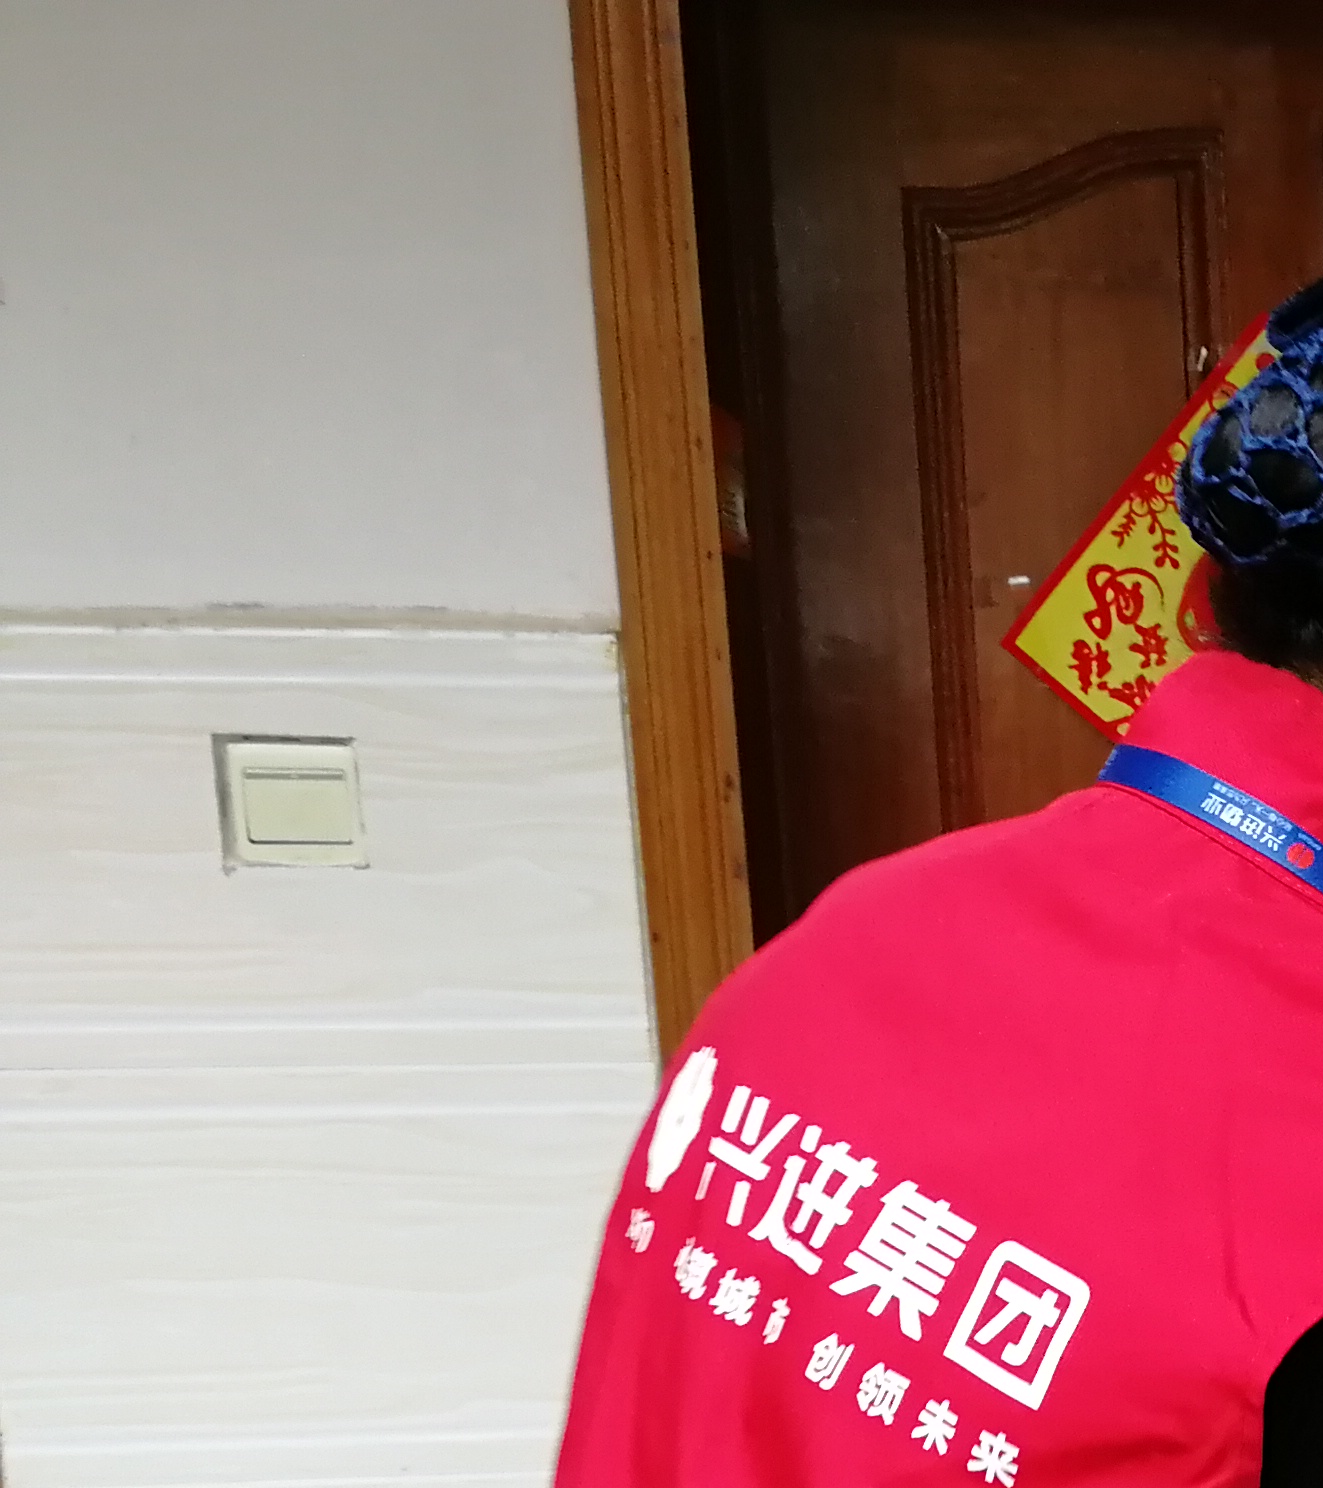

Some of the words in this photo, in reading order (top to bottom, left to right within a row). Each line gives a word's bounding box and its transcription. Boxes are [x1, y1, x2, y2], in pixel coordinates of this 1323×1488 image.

[1201, 791, 1288, 852] 兴进物业
[696, 1085, 1091, 1411] 兴进集团
[804, 1332, 1020, 1488] 创领未来
